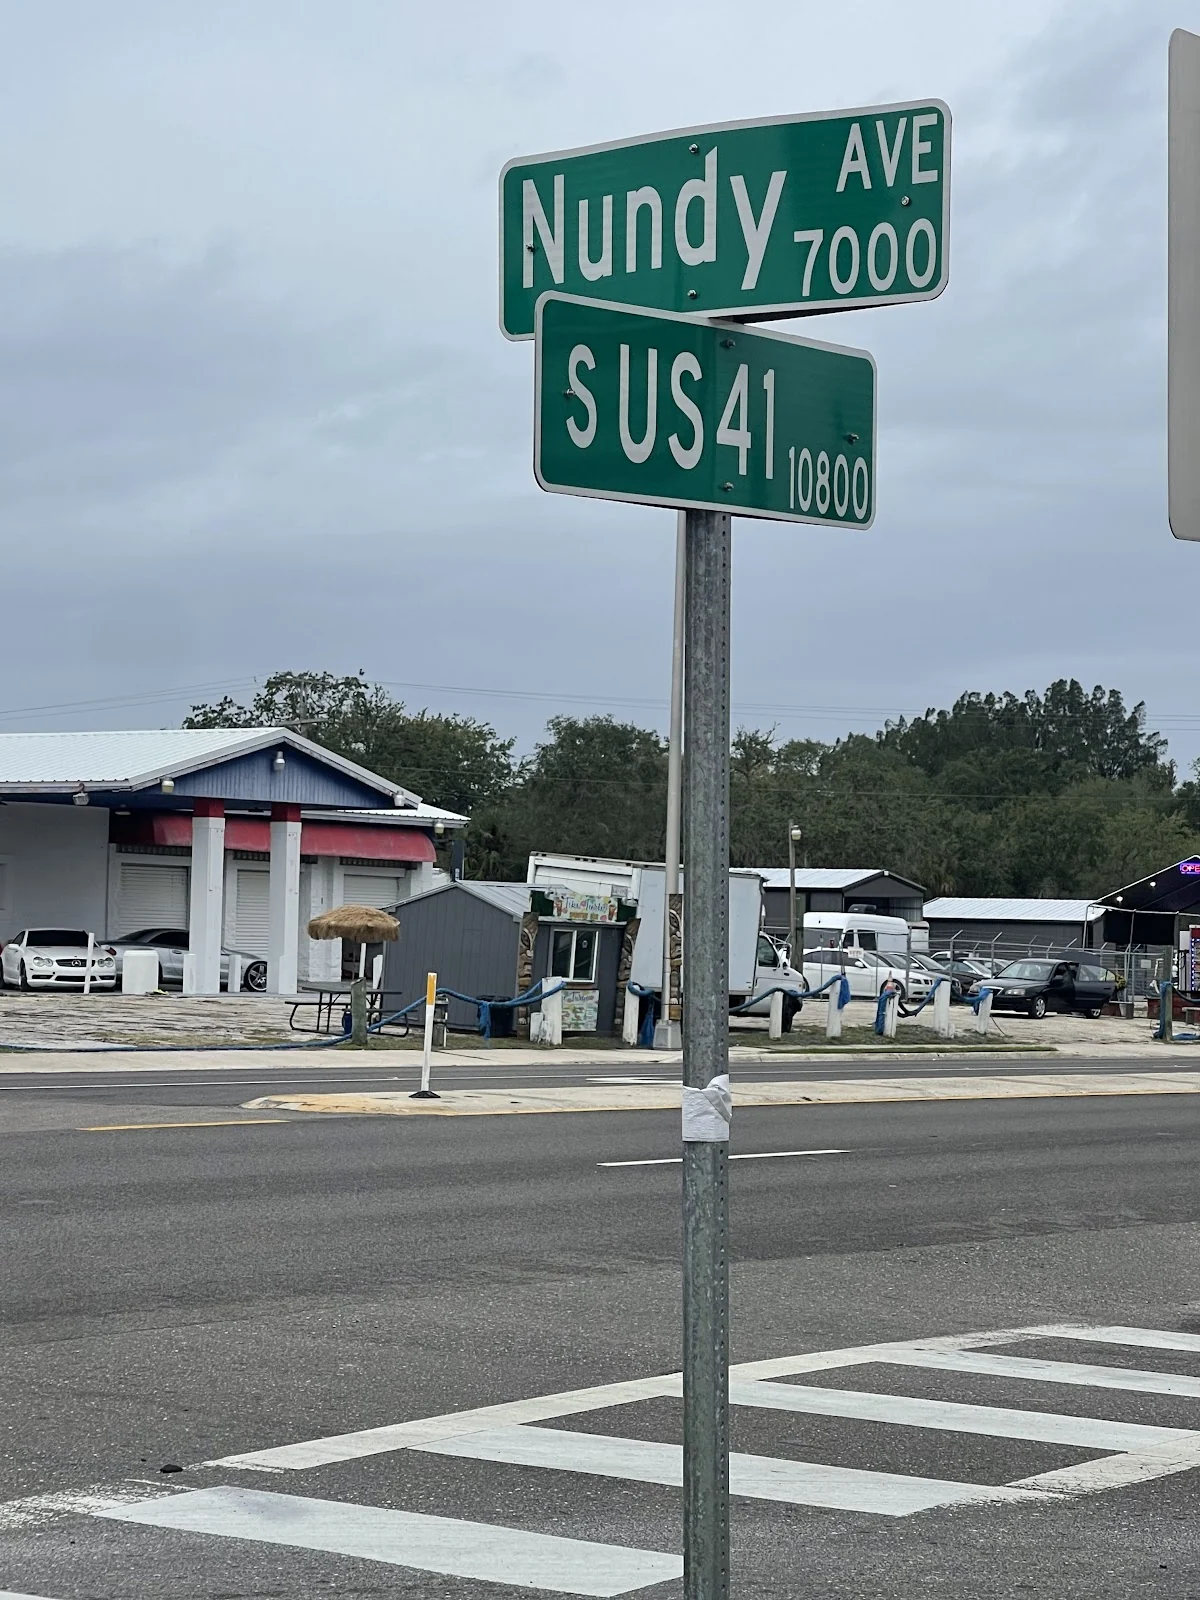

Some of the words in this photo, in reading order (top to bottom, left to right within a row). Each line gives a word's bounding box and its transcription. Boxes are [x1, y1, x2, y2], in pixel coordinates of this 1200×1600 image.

[522, 146, 788, 291] Nundy
[836, 113, 939, 192] AVE
[794, 218, 937, 297] 7000
[565, 343, 598, 449] S
[788, 445, 869, 520] 10800
